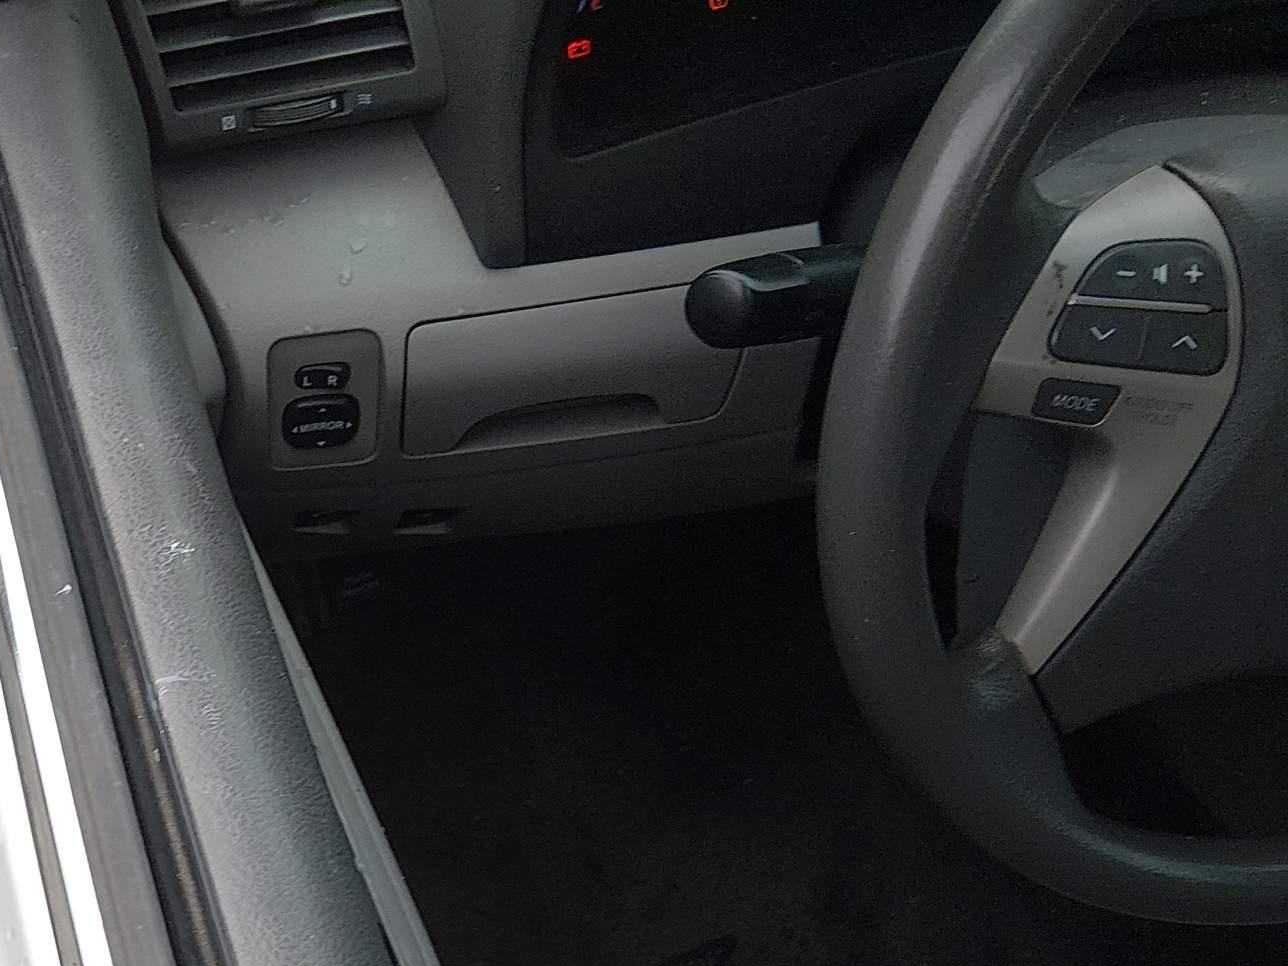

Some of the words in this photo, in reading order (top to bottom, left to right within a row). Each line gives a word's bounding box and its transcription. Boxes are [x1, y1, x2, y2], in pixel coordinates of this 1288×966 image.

[302, 375, 312, 386] L
[327, 375, 338, 386] R
[1050, 394, 1101, 412] MODE
[299, 420, 344, 433] MIRROR
